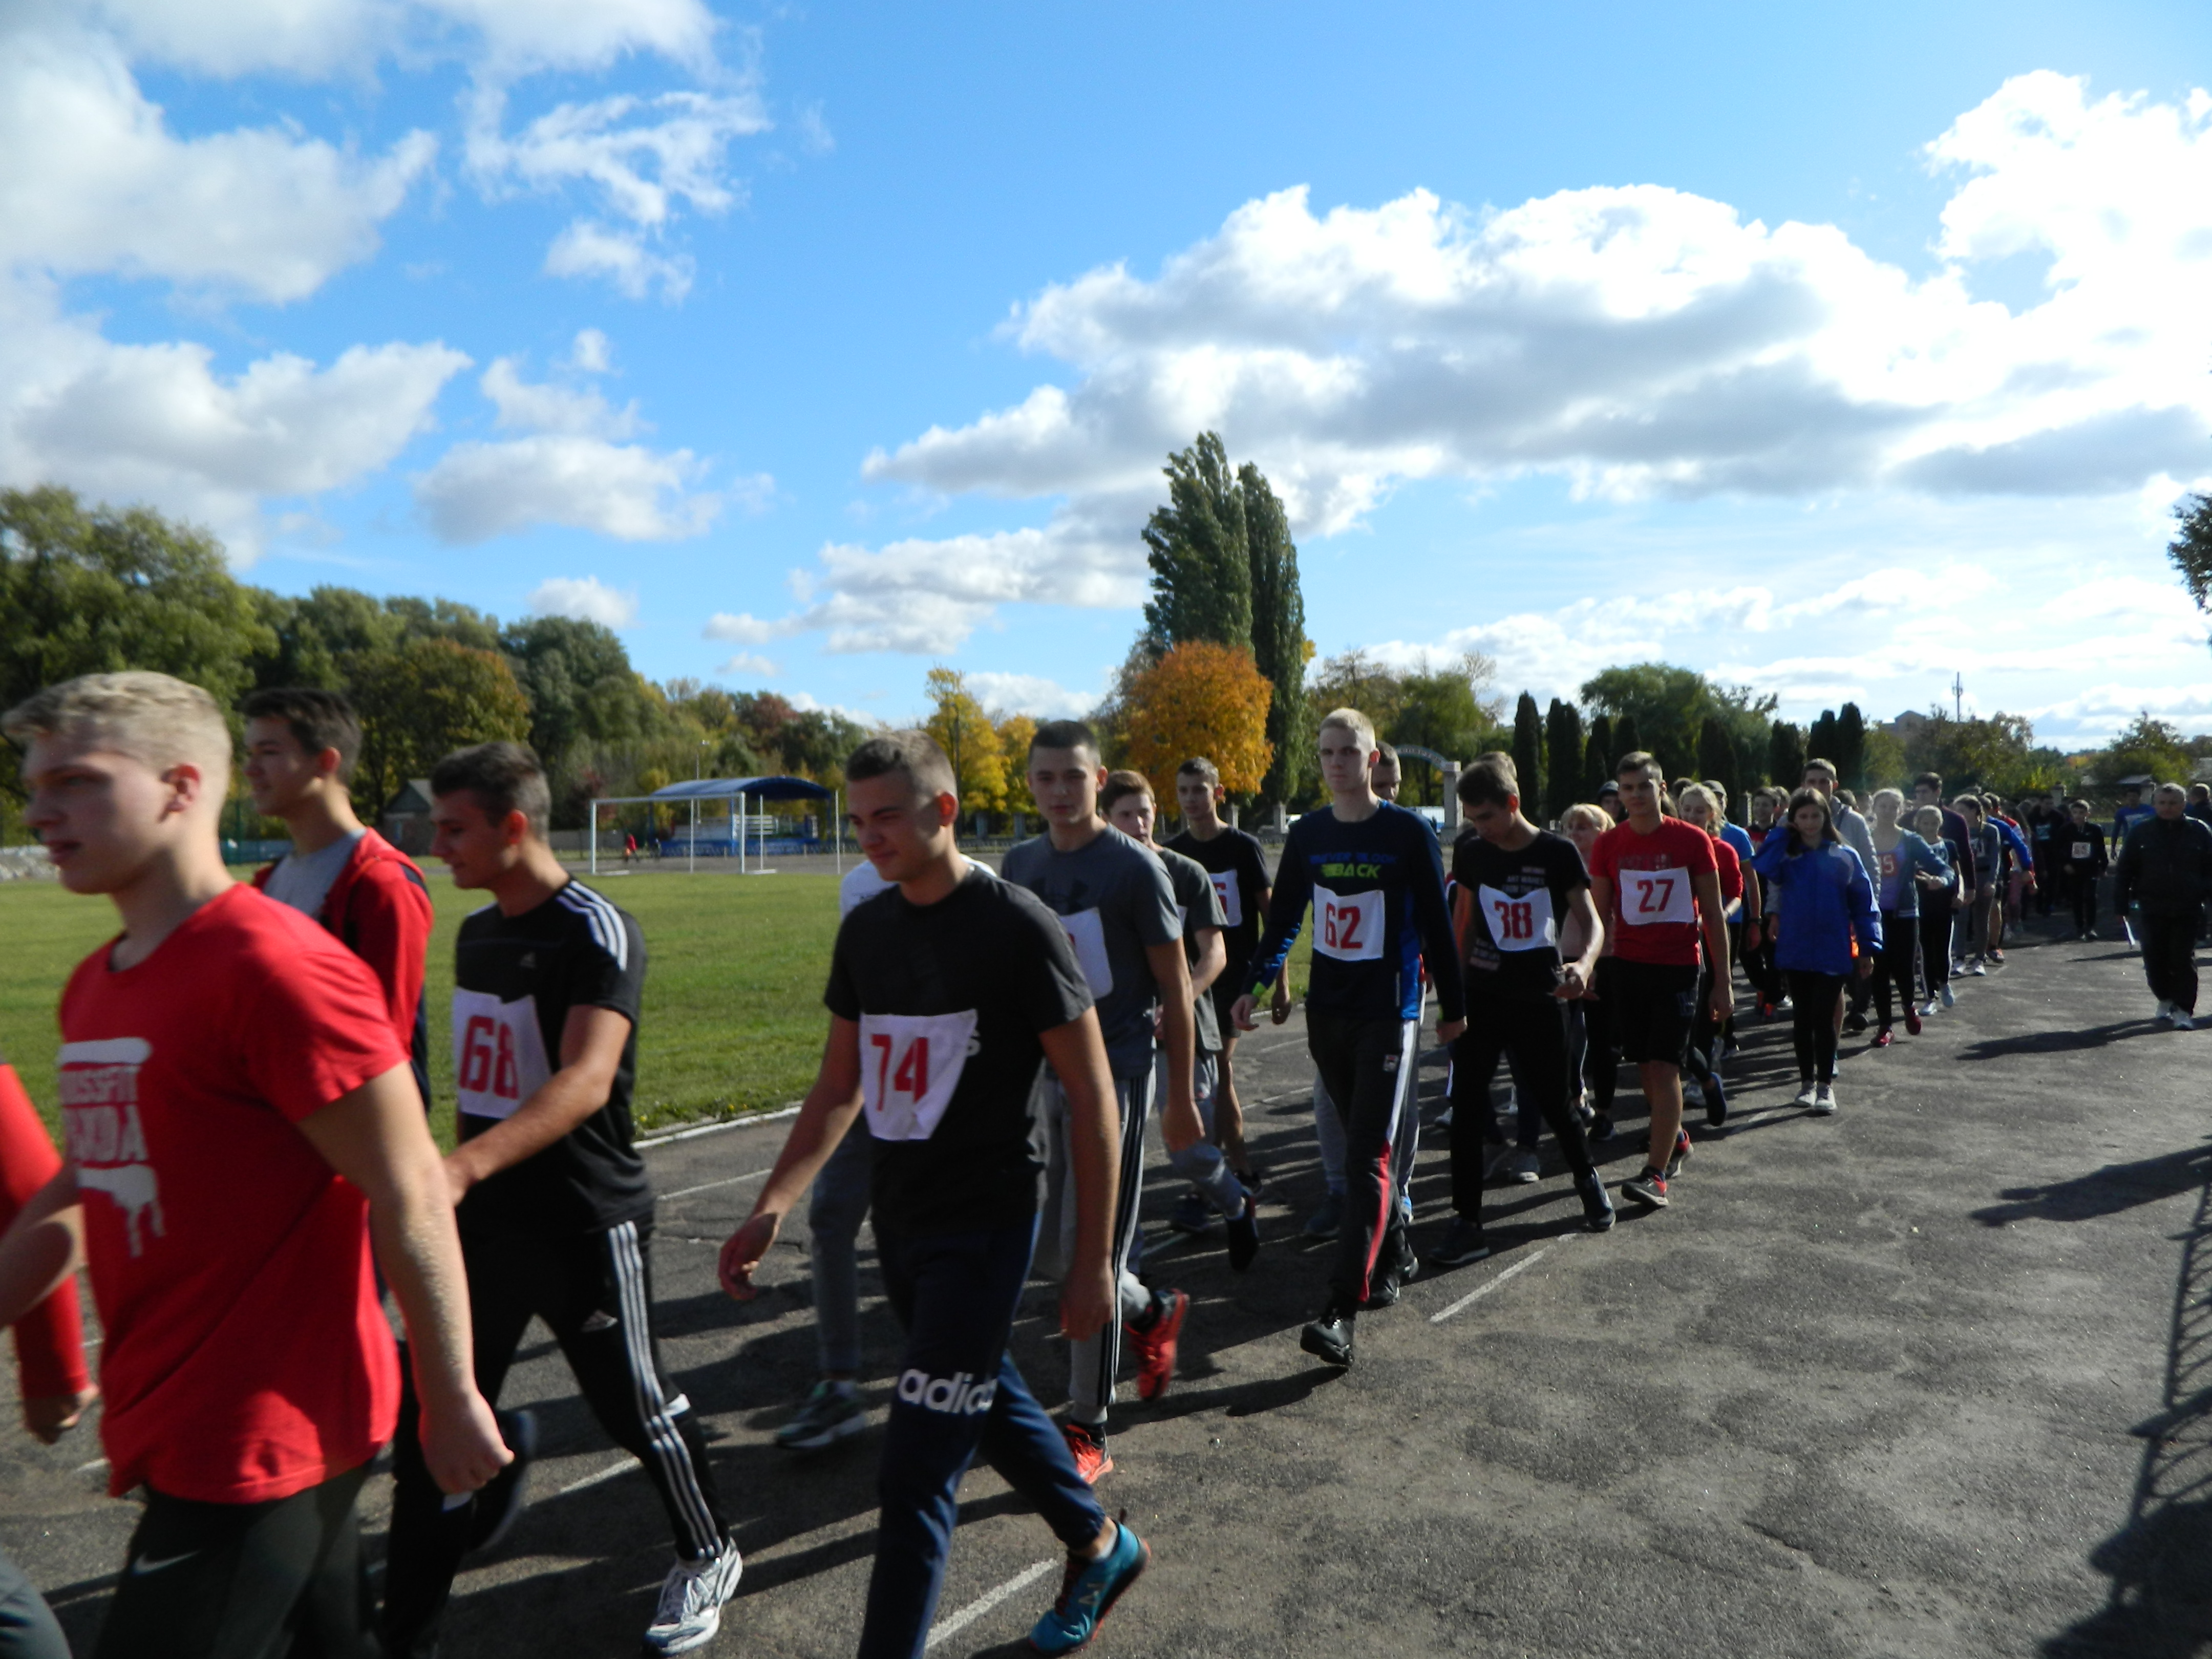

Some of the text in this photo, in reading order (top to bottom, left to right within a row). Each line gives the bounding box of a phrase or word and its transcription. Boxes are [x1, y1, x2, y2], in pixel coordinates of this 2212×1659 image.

[1323, 863, 1381, 879] BACK
[1637, 879, 1674, 913] 27
[1325, 902, 1363, 949] 62
[459, 1015, 519, 1100] 68
[872, 1034, 928, 1112] 74
